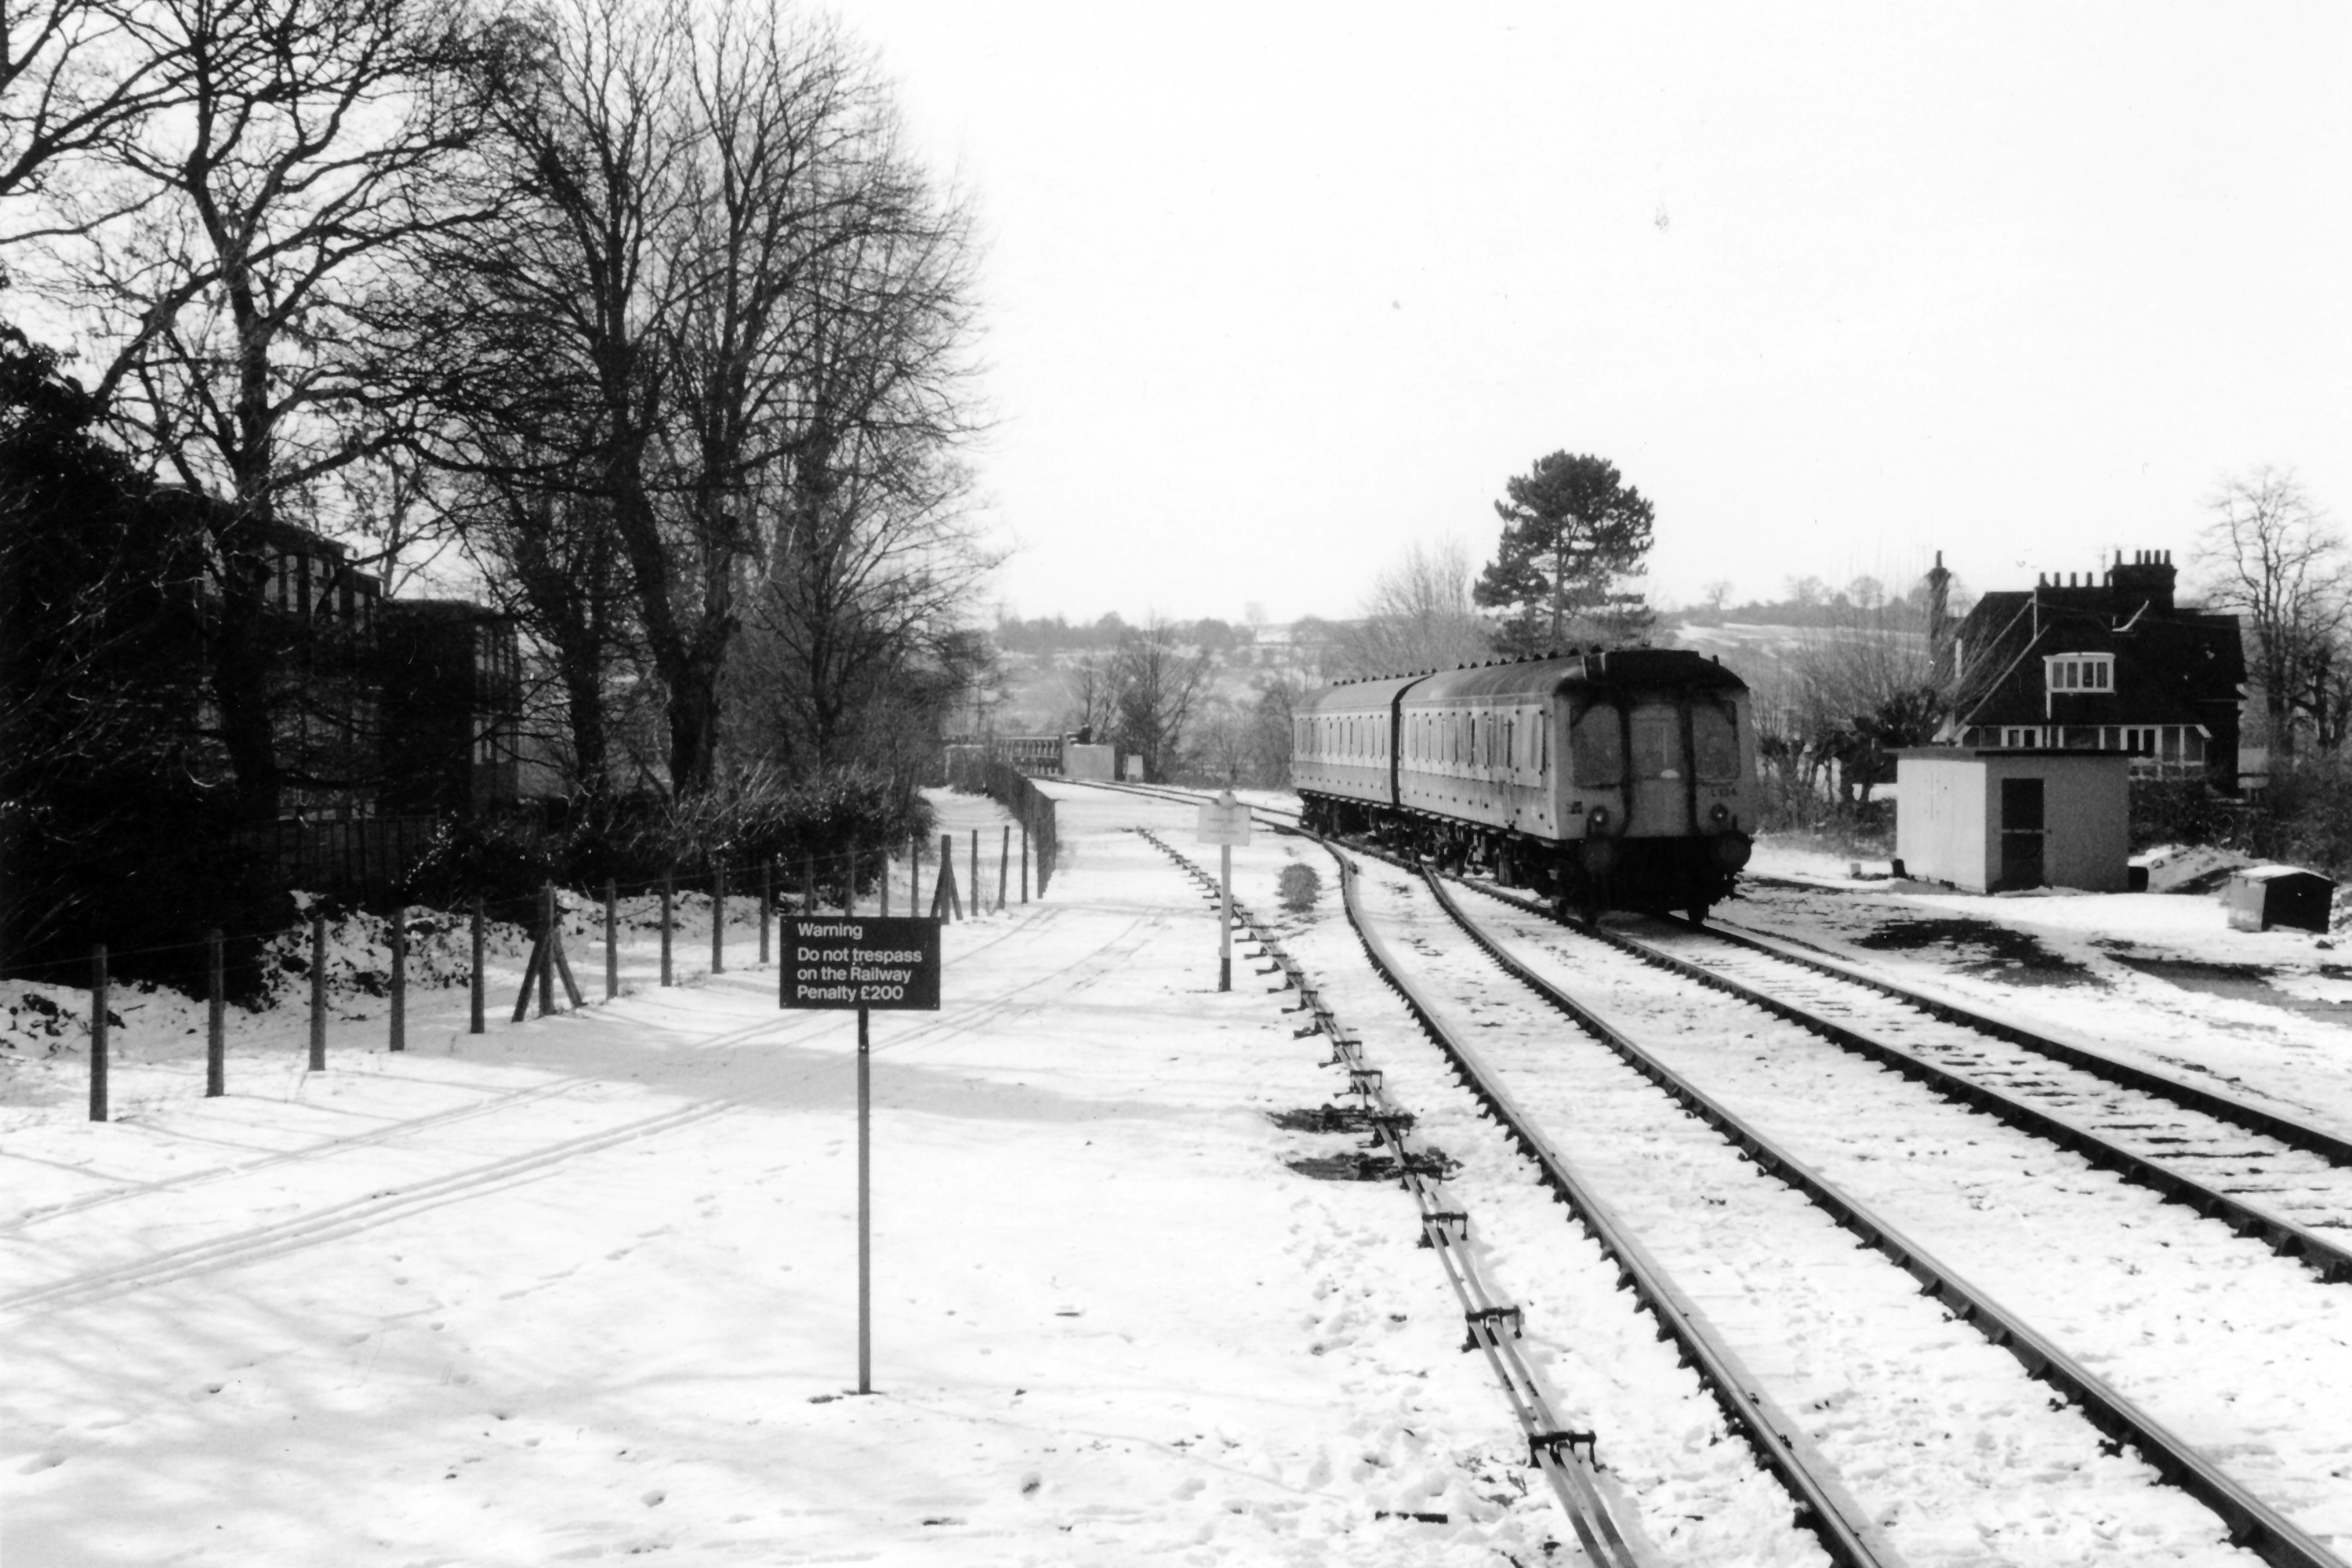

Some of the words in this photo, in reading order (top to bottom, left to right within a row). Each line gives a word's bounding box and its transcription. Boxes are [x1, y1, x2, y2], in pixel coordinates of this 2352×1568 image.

[798, 923, 862, 940] Warning
[798, 947, 819, 961] Do
[823, 948, 849, 961] not
[852, 948, 922, 964] trespass
[797, 969, 817, 980] on
[821, 967, 847, 981] the
[851, 967, 911, 984] Railway
[797, 985, 856, 1002] Penalty
[860, 985, 903, 1000] £200
